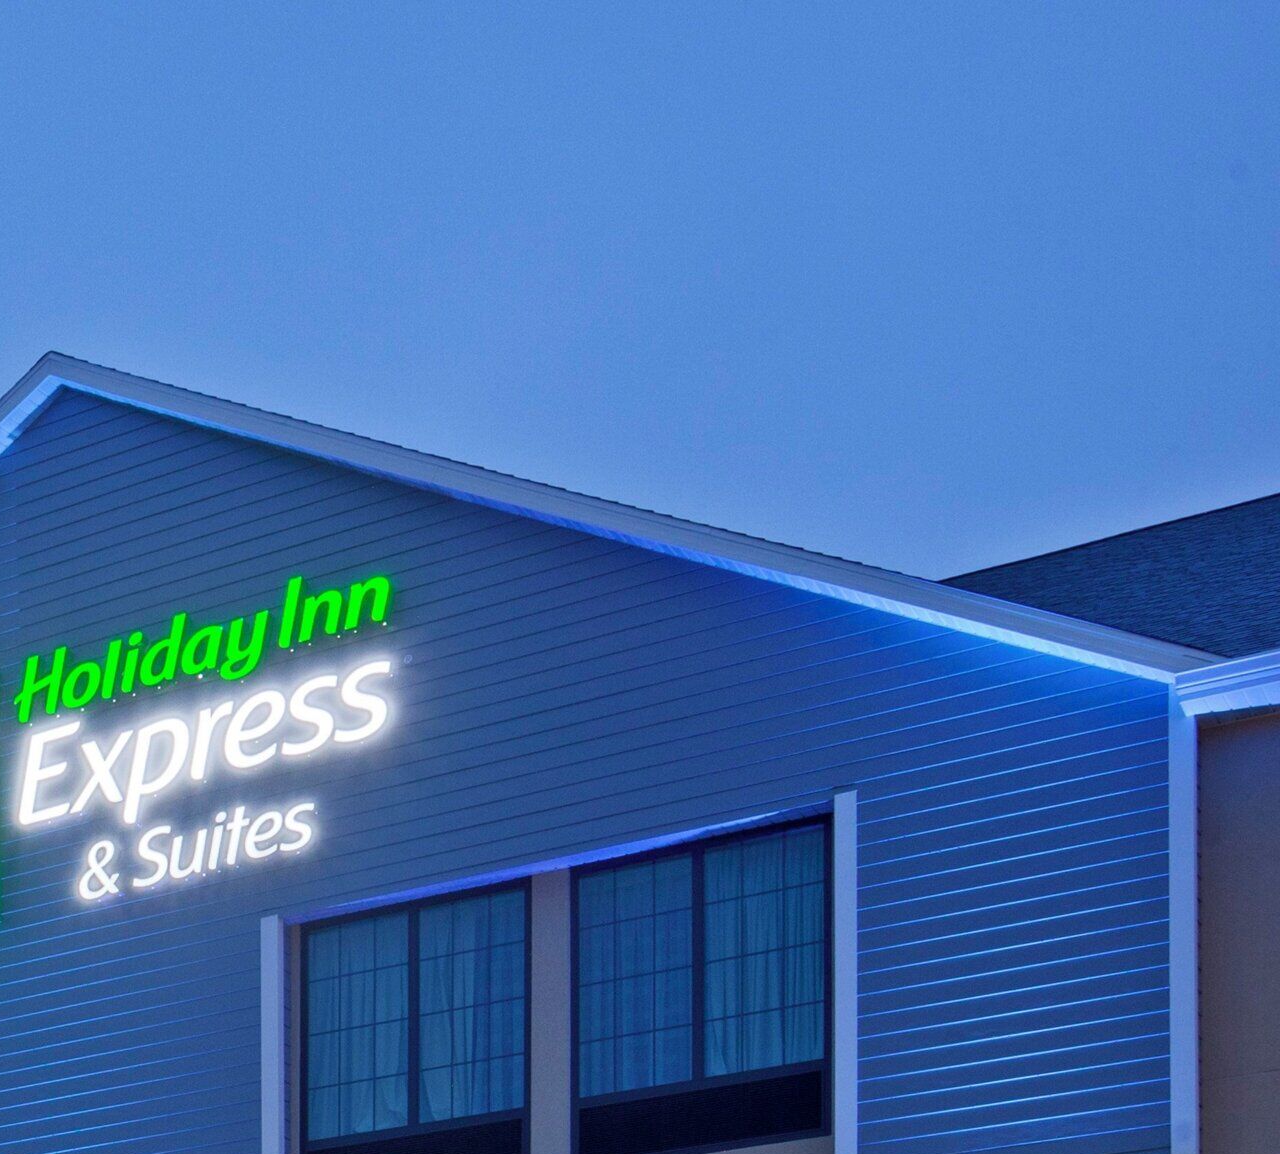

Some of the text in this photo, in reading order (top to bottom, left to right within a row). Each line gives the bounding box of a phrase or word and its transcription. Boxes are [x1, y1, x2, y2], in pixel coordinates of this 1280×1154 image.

[14, 575, 390, 722] Holiday Inn
[18, 660, 391, 825] Express
[77, 802, 315, 900] & Suites
